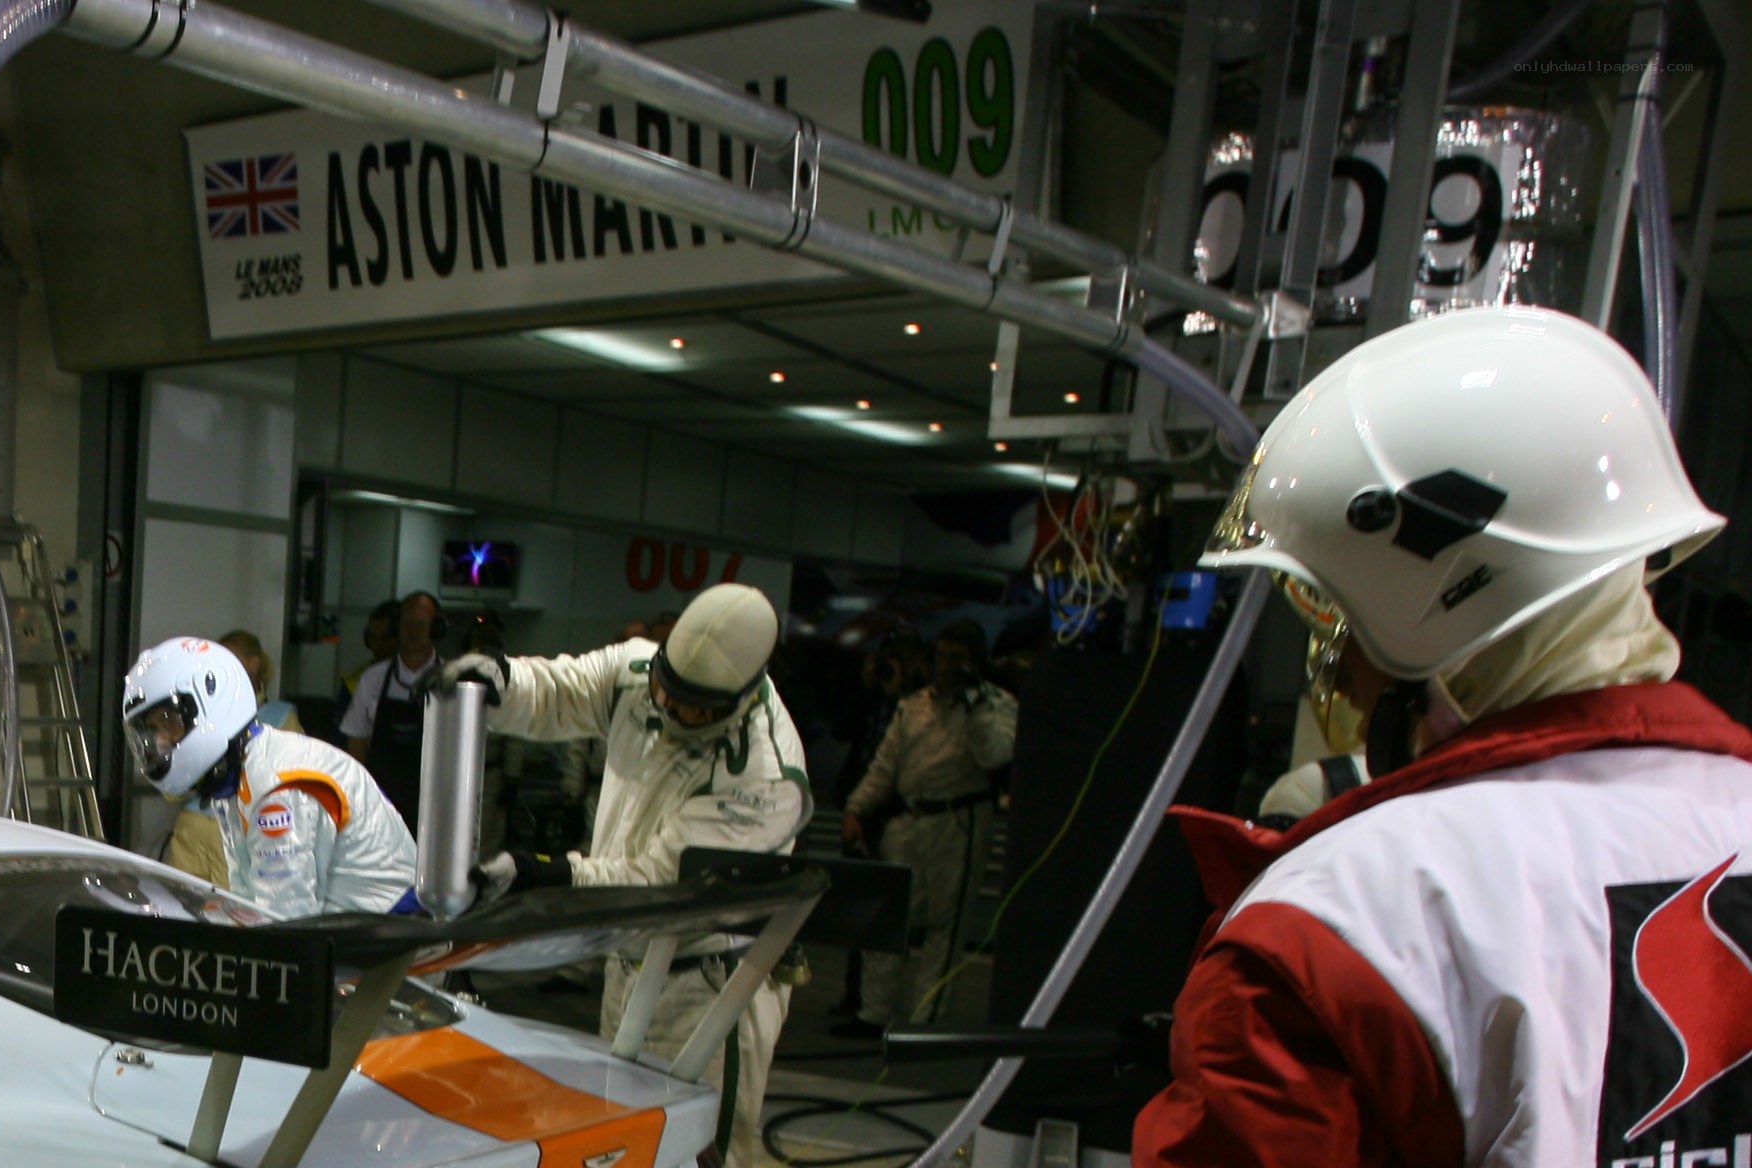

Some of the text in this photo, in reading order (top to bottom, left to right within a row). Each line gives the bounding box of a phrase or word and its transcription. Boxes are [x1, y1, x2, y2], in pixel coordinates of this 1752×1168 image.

[862, 25, 1014, 178] 009
[327, 137, 508, 290] ASTON
[238, 275, 304, 301] 2008
[257, 253, 303, 277] MANS
[80, 927, 299, 1004] HACKETT
[132, 990, 238, 1028] LONDON
